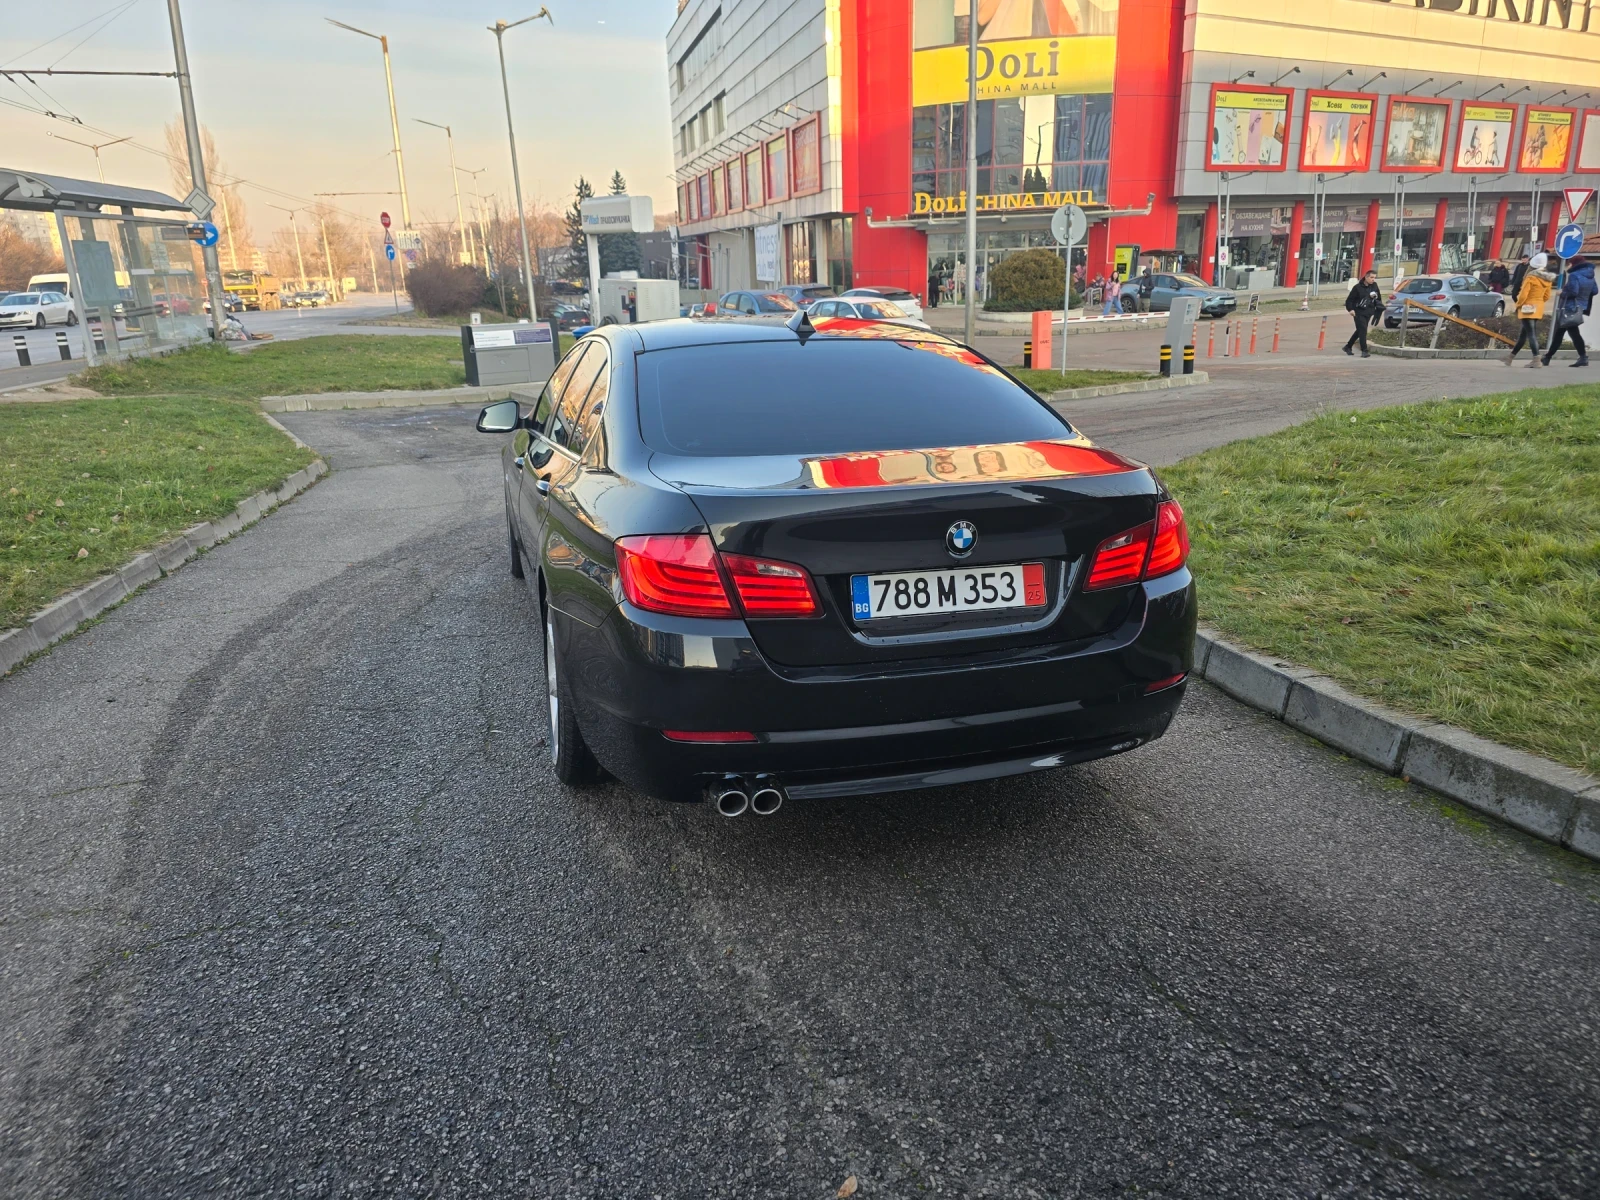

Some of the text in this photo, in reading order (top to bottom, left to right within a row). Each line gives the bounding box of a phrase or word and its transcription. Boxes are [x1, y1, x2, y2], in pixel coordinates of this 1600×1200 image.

[977, 82, 1057, 94] HINA MALL
[1043, 190, 1098, 206] MALL
[1235, 211, 1271, 220] ОБЗАВЕЖДАНЕ
[950, 522, 976, 534] BMW
[873, 571, 1017, 612] 788 M 353
[1027, 590, 1041, 601] 25
[855, 603, 869, 613] BG
